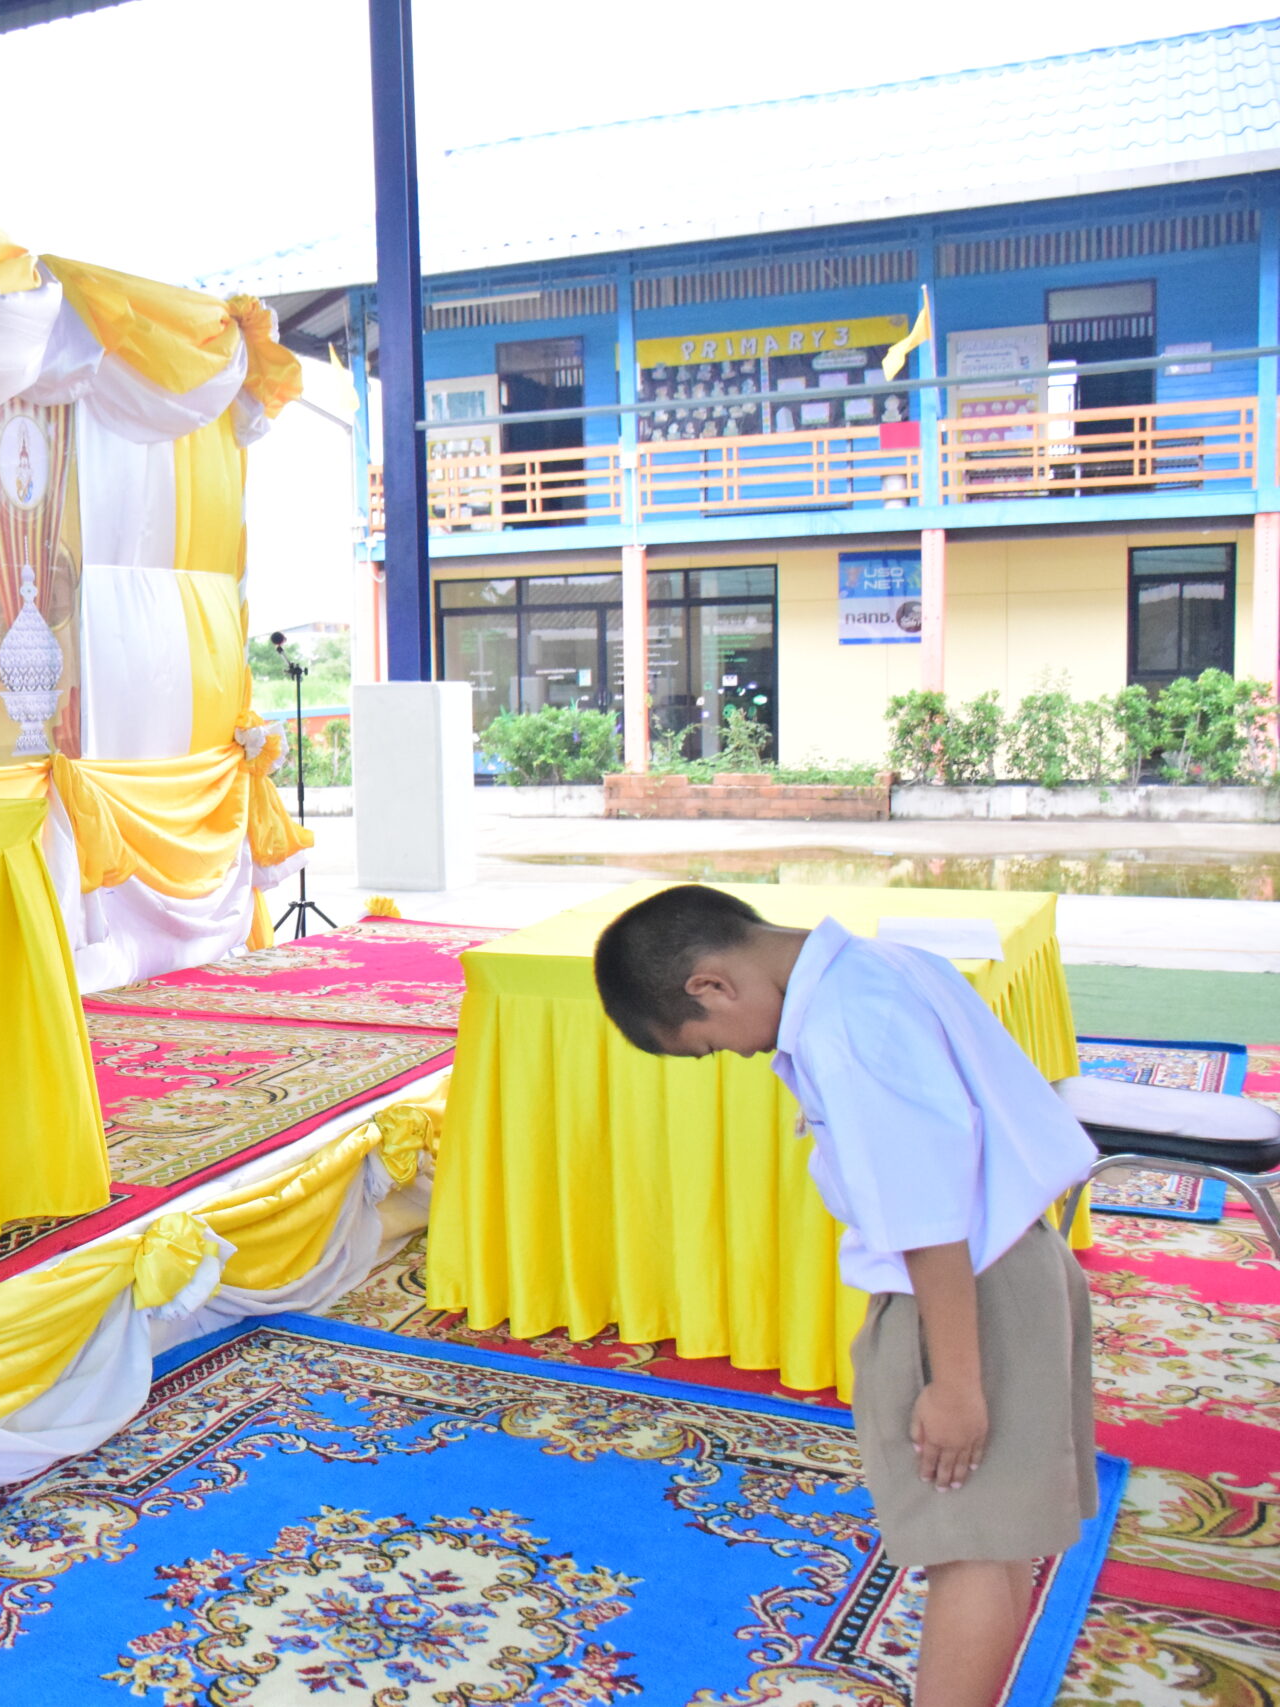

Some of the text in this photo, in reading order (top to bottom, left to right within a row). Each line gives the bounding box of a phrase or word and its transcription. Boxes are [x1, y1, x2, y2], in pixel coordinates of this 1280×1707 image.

[681, 331, 825, 361] PRIMARY
[834, 327, 850, 347] 3
[863, 566, 903, 578] USO
[863, 579, 904, 590] NET
